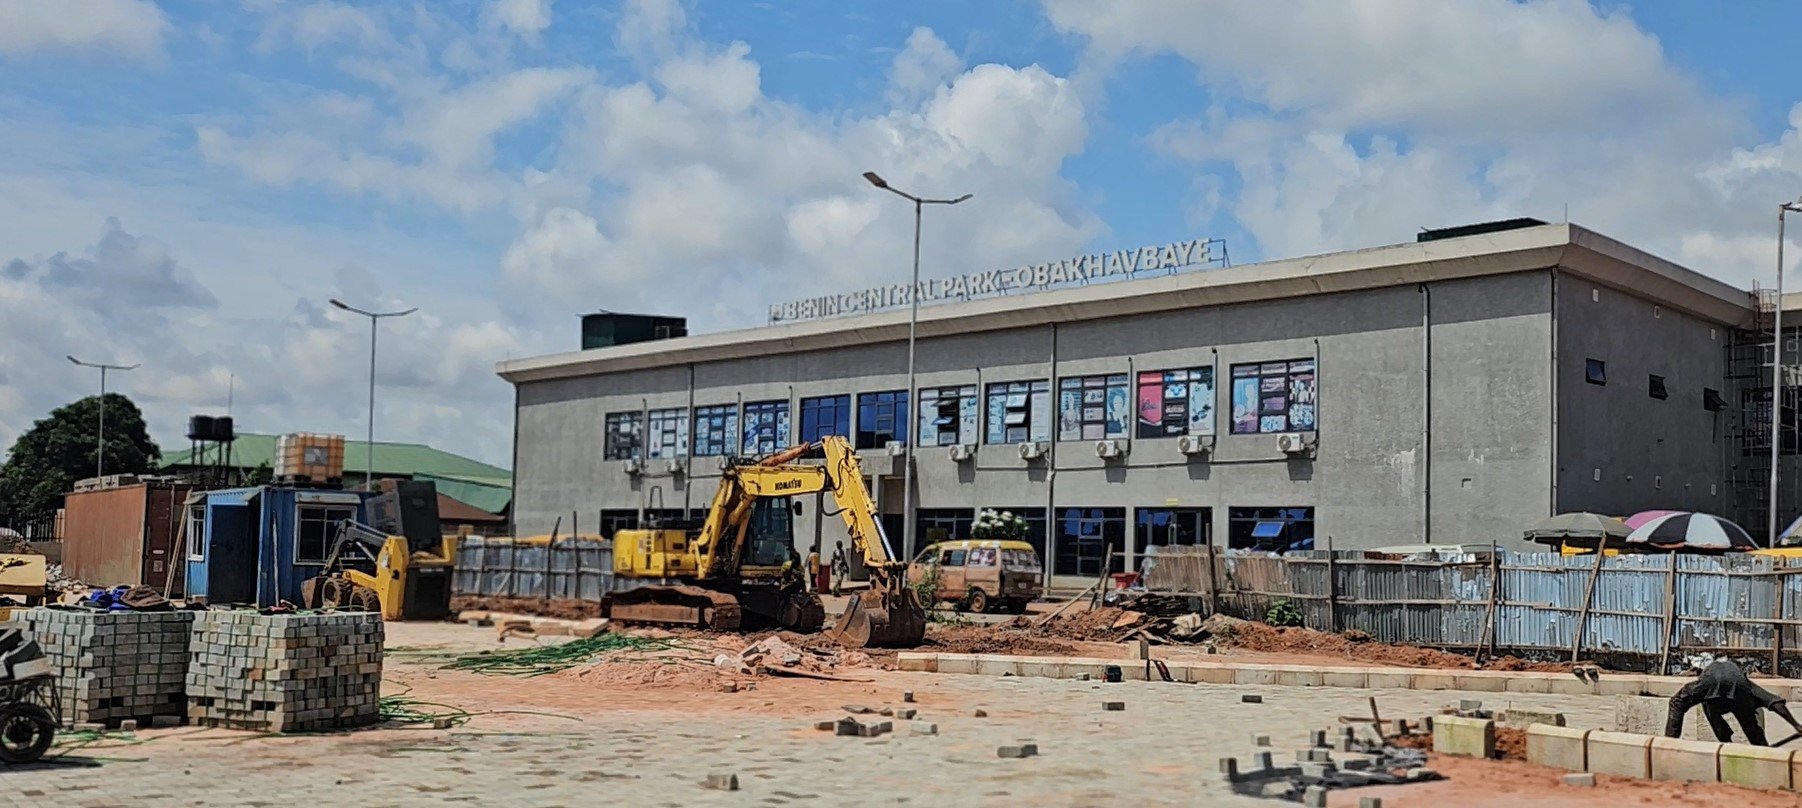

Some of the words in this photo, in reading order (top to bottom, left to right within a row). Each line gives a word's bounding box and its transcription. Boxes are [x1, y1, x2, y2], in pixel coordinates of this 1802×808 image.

[787, 291, 843, 320] BENIN
[845, 279, 940, 312] CENTRAL
[941, 269, 998, 298] PARK
[774, 478, 803, 491] KOMATSU
